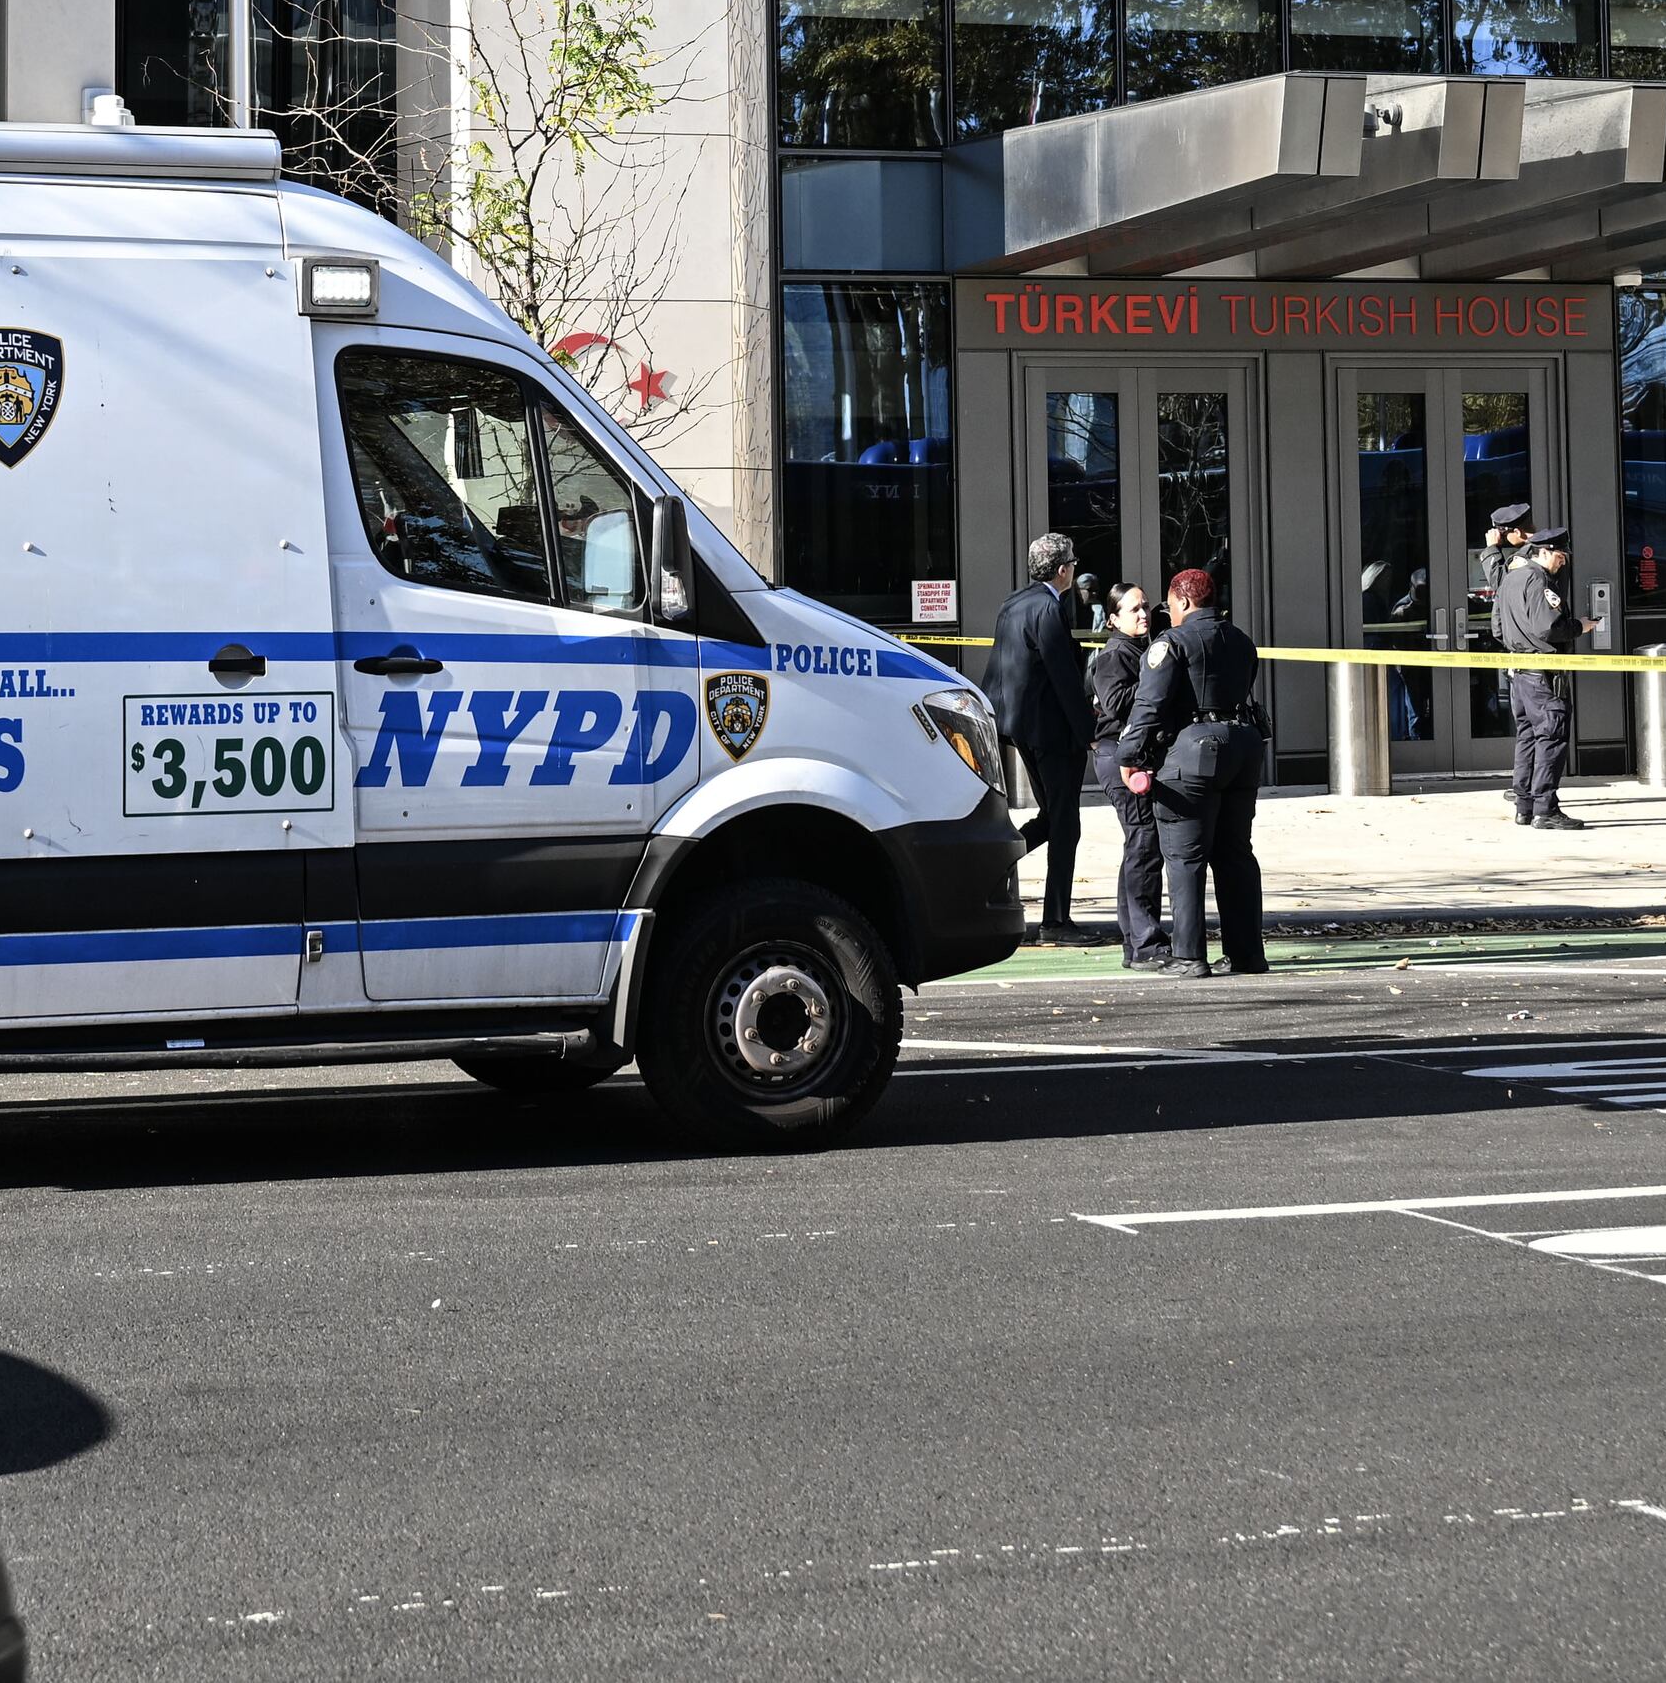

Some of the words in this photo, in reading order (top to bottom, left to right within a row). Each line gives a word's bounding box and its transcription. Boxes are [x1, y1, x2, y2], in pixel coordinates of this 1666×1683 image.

[985, 285, 1199, 335] TÜRKEVİ
[1219, 295, 1417, 337] TURKISH
[1435, 296, 1588, 337] HOUSE
[24, 415, 46, 444] NEW
[40, 379, 57, 412] YORK
[775, 643, 873, 677] POLICE
[708, 684, 766, 701] DEPARTMENT
[720, 675, 754, 686] POLICE
[140, 702, 244, 726] REWARDS
[253, 702, 281, 724] UP
[289, 701, 317, 723] TO
[710, 710, 722, 731] CITY
[720, 734, 731, 745] OF
[742, 730, 756, 749] NEW
[754, 705, 766, 728] YORK
[353, 689, 698, 788] NYPD
[130, 735, 326, 809] $3,500
